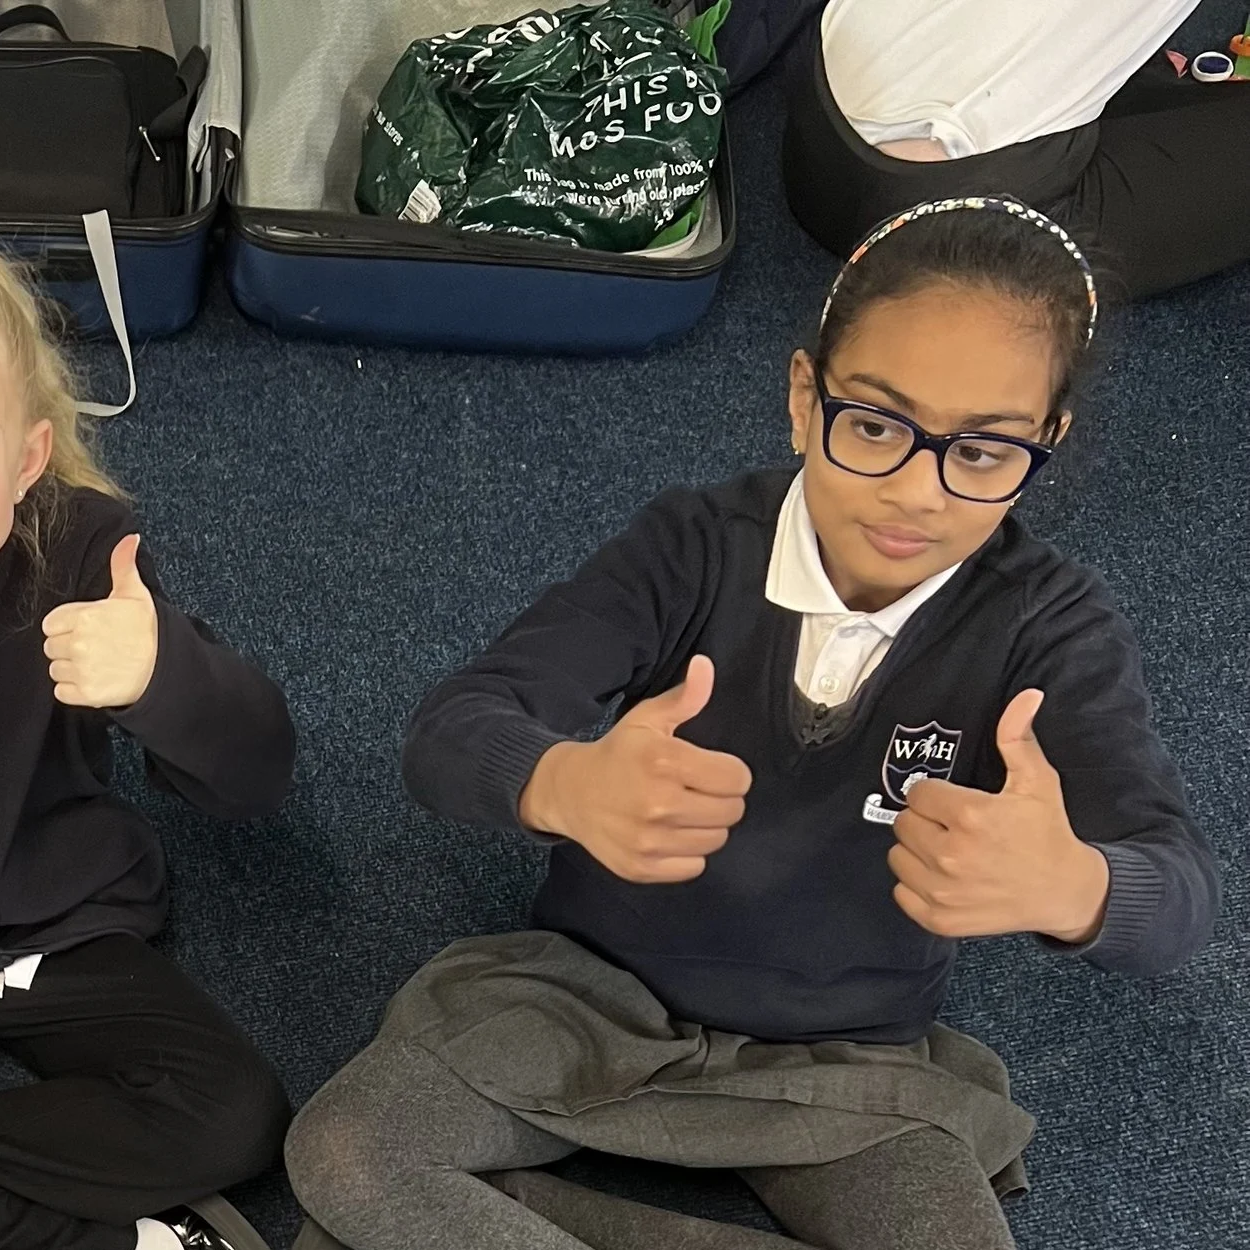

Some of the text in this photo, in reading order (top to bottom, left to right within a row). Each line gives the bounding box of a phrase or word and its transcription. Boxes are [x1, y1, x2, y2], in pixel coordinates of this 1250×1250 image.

[585, 75, 668, 123] THIS
[524, 168, 552, 185] This
[594, 173, 630, 191] made
[634, 167, 665, 180] from
[668, 159, 704, 176] 100%
